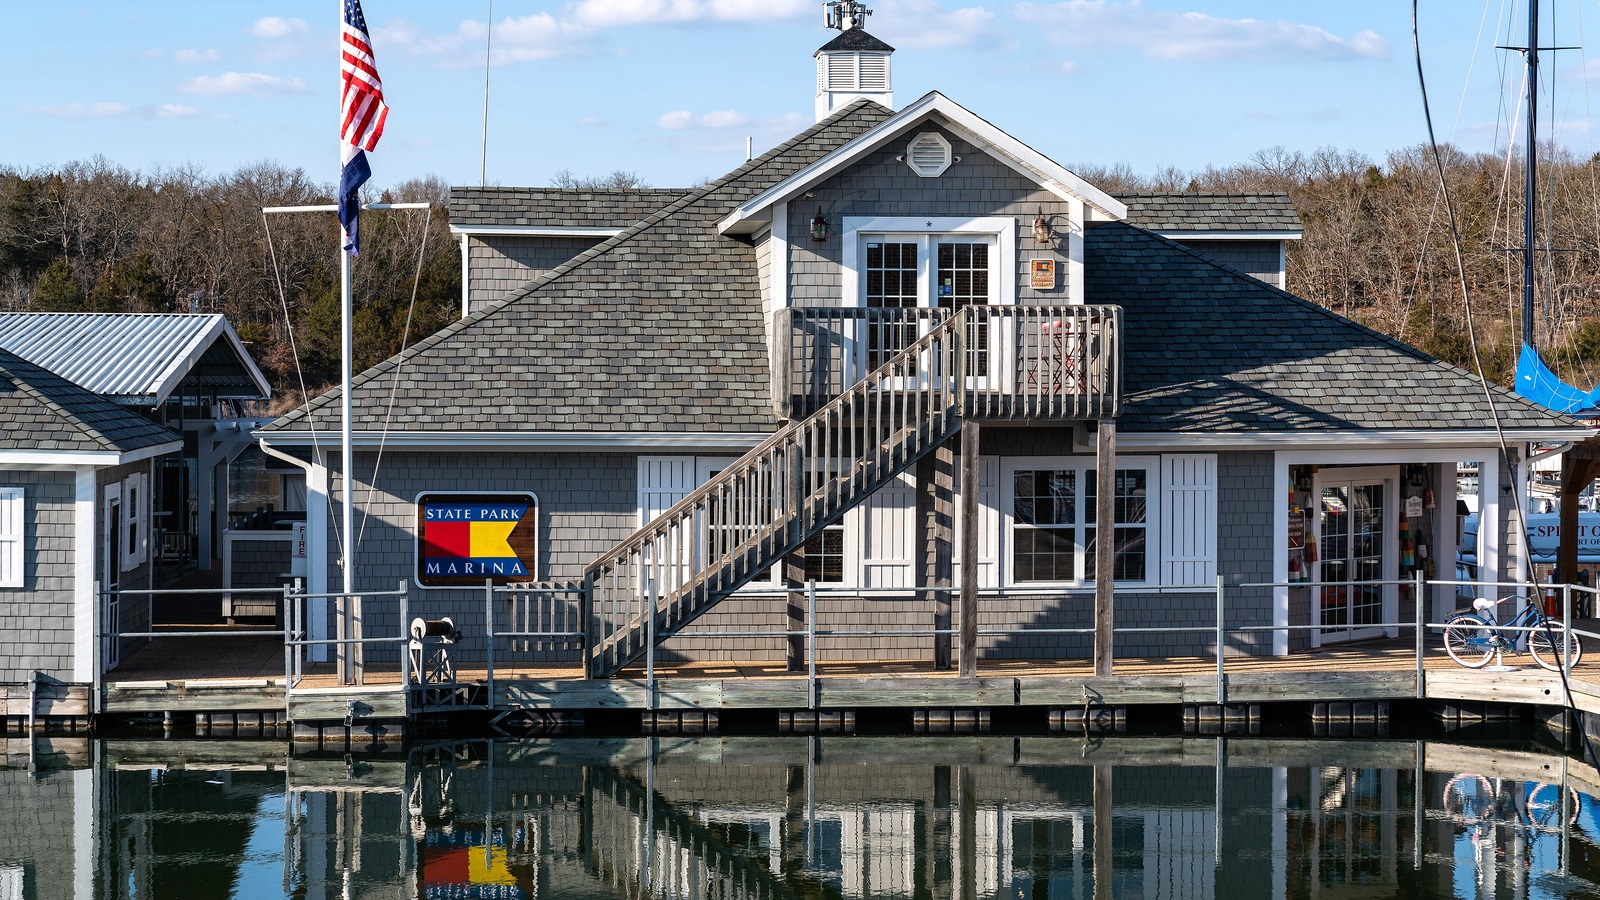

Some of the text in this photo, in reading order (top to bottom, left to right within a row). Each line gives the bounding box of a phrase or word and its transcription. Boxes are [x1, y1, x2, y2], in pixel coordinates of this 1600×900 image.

[426, 508, 520, 519] STATE PARK
[1538, 526, 1588, 537] SPIT
[426, 562, 522, 574] MARINA
